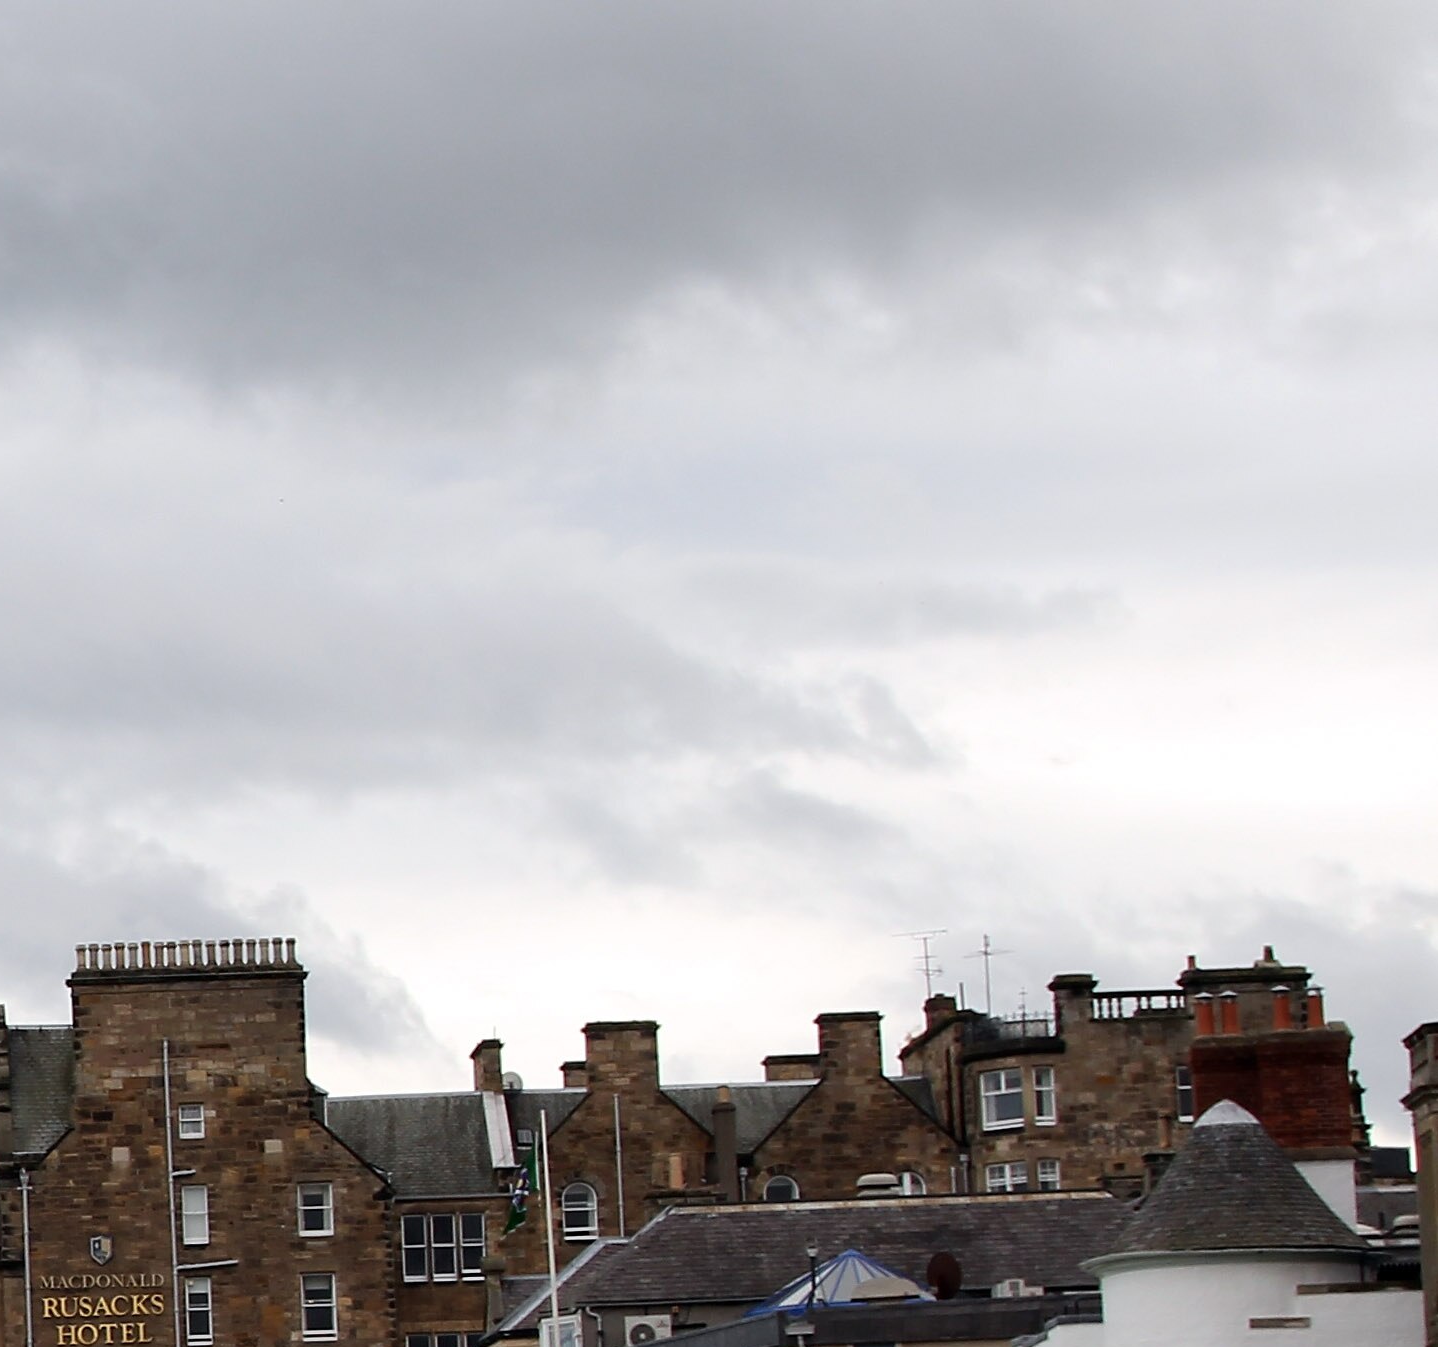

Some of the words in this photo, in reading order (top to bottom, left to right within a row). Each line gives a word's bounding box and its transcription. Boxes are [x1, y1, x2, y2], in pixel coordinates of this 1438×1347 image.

[39, 1273, 165, 1290] MACDONALD
[42, 1293, 165, 1319] RUSACKS
[56, 1321, 153, 1347] HOTEL
